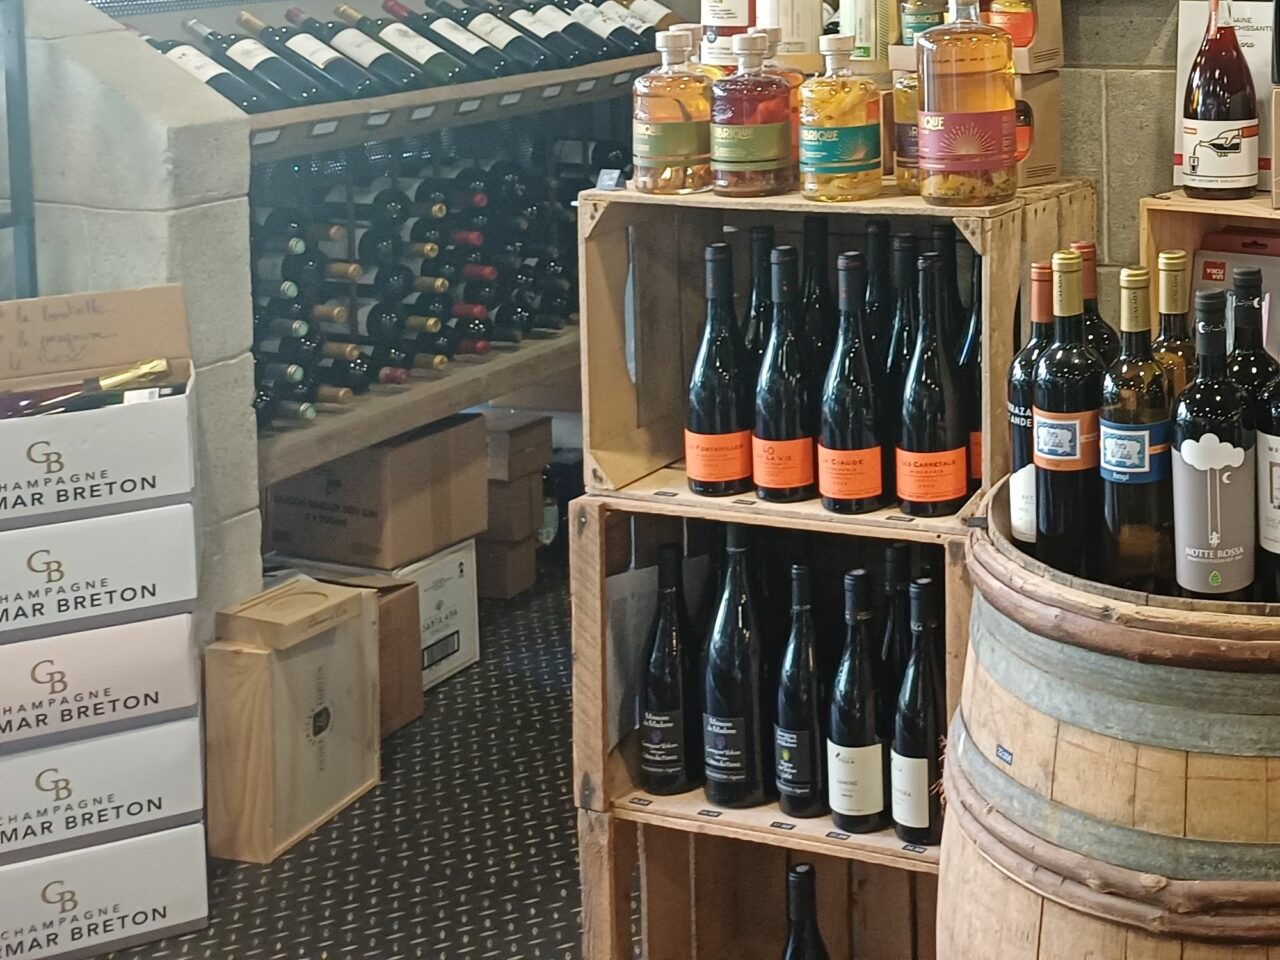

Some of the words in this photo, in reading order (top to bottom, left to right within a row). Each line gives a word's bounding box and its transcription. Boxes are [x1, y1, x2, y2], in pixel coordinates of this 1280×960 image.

[26, 441, 65, 474] GB
[56, 476, 156, 503] BRETON
[27, 549, 65, 583] GB
[1185, 546, 1214, 558] NOTTE
[1218, 546, 1244, 557] ROSSA
[57, 584, 156, 613] BRETON
[31, 660, 68, 694] GB
[60, 691, 159, 722] BRETON
[35, 768, 72, 801] GB
[65, 797, 162, 830] BRETON
[41, 880, 78, 913] GB
[1, 904, 121, 940] CHAMPAGNE
[71, 906, 167, 941] BRETON
